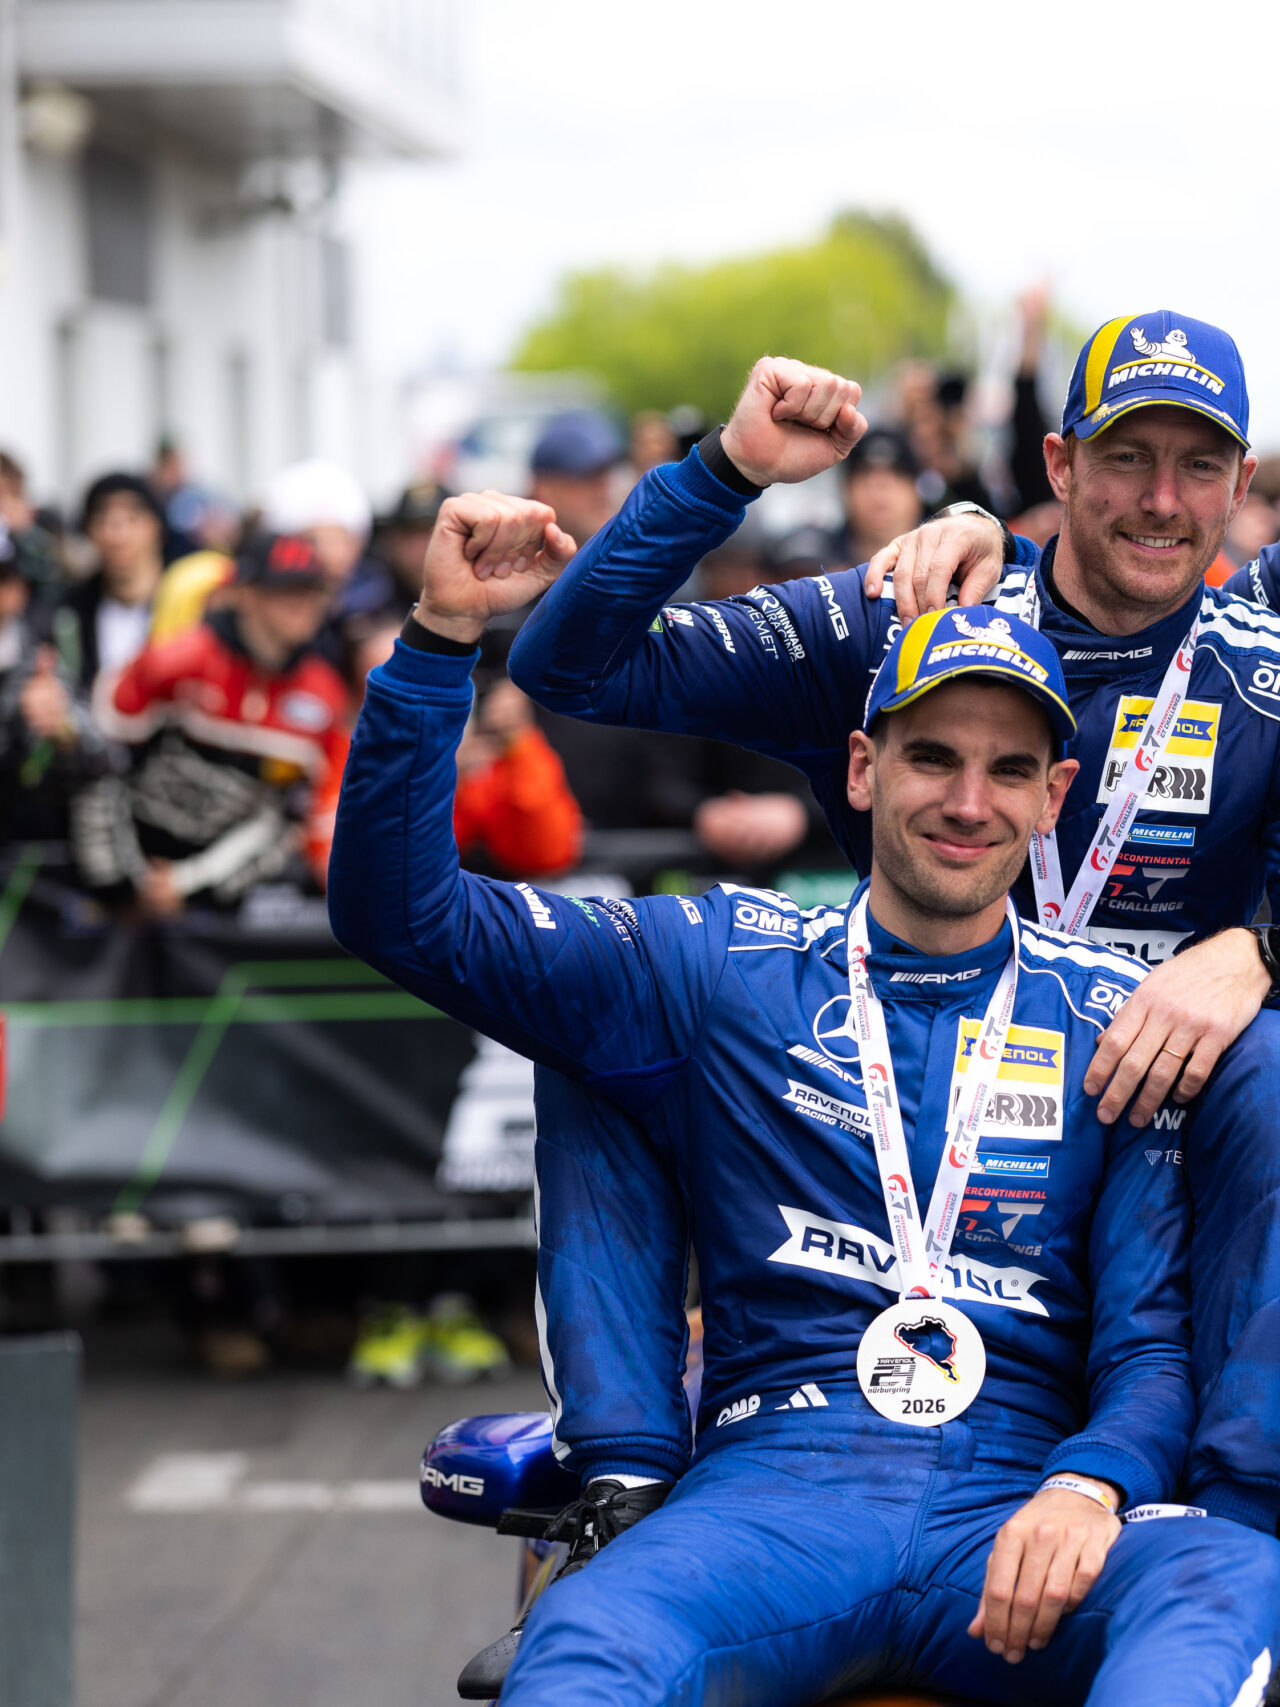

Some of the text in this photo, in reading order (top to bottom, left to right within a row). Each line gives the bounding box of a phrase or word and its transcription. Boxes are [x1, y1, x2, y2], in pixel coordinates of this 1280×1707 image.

[1107, 362, 1223, 396] MICHELIN
[926, 644, 1048, 684] MICHELIN
[1092, 646, 1152, 661] AMG
[1132, 828, 1192, 839] MICHELIN
[1108, 899, 1184, 913] CHALLENGE
[736, 907, 798, 933] OMP
[919, 968, 981, 984] AMG
[795, 1088, 871, 1127] RAVENOL
[795, 1105, 867, 1139] RACING TEAM
[985, 1159, 1047, 1170] MICHELIN
[902, 1399, 946, 1414] 2026
[422, 1467, 484, 1496] AMG
